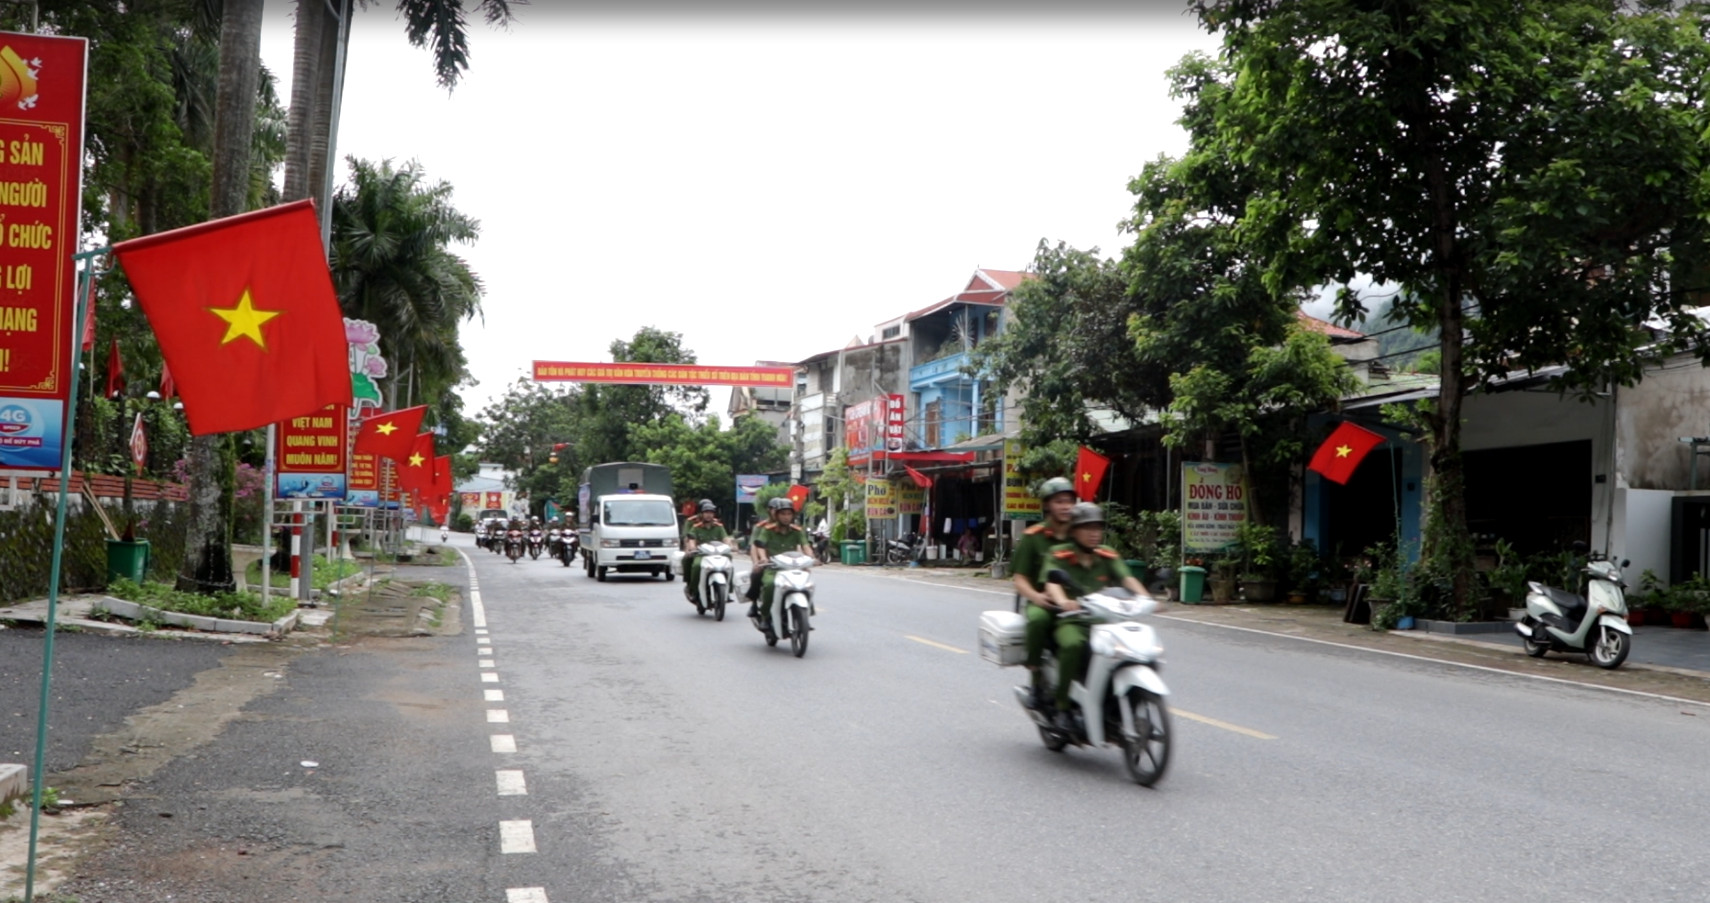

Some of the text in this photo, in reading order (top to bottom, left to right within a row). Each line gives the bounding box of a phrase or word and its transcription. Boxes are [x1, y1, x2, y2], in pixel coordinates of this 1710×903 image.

[10, 133, 43, 166] SẢN
[9, 220, 52, 250] CHỨC
[6, 264, 32, 295] LỢI
[0, 409, 26, 422] 4G
[292, 417, 333, 430] VIỆT NAM
[286, 435, 338, 446] QUANG VINH
[286, 452, 338, 465] MUÔN NĂM!
